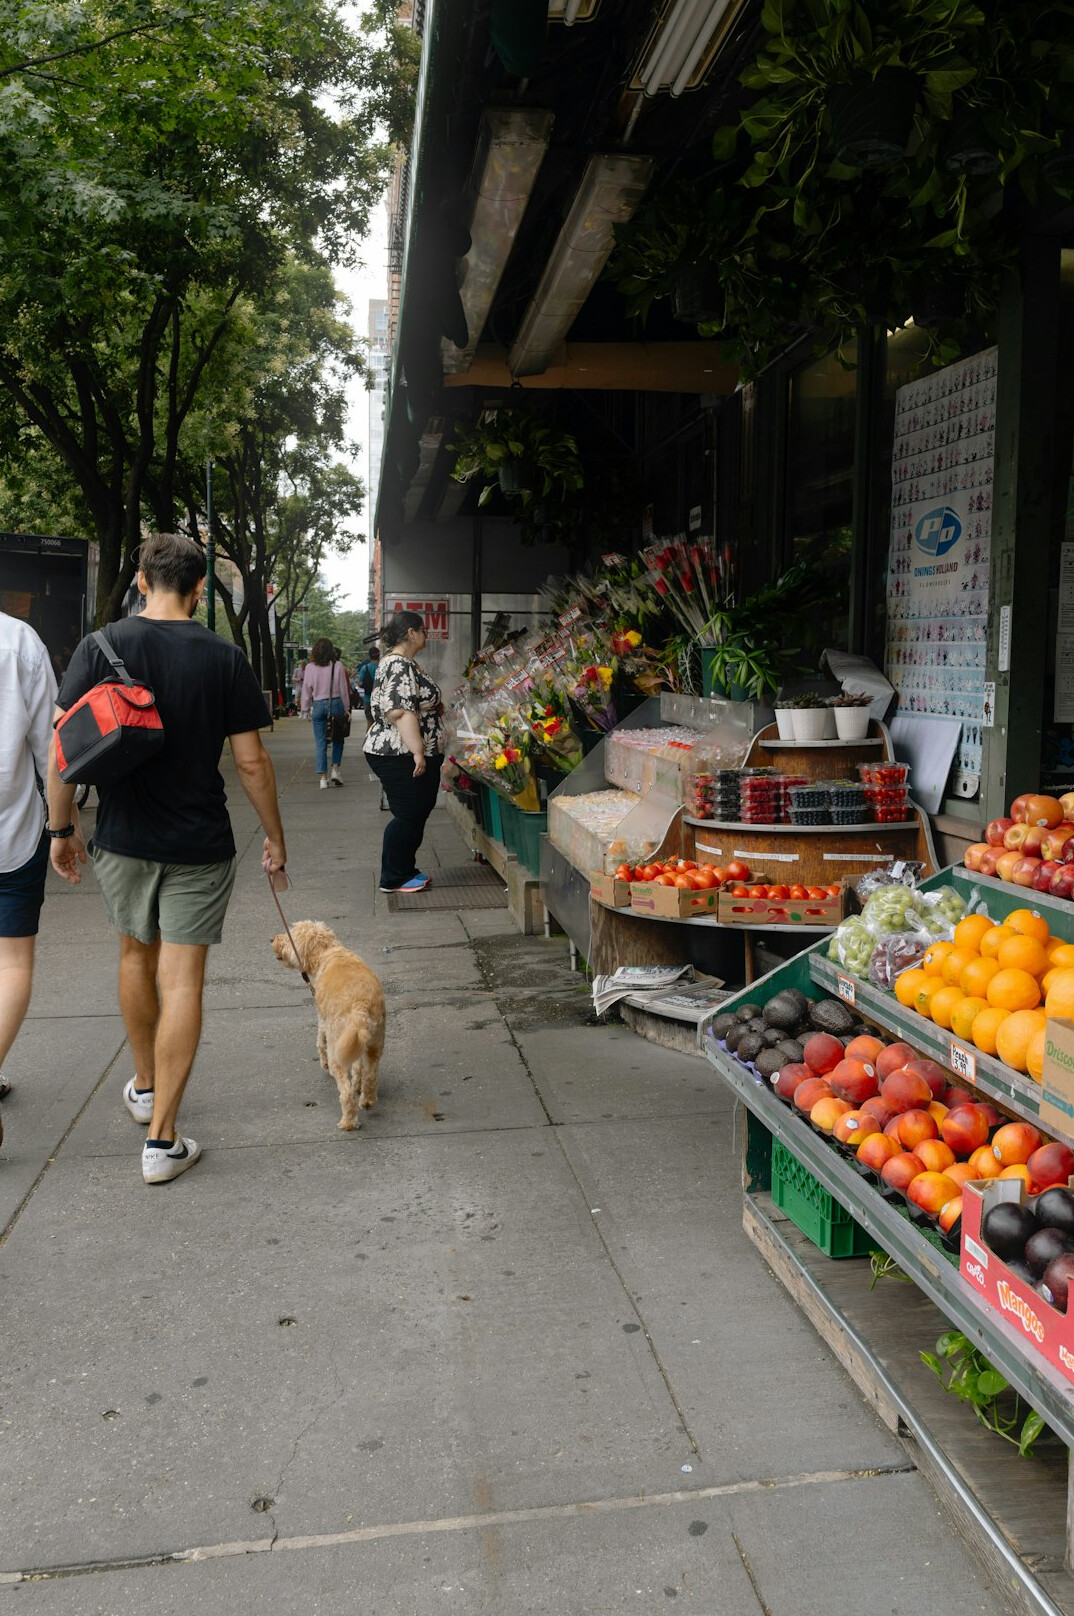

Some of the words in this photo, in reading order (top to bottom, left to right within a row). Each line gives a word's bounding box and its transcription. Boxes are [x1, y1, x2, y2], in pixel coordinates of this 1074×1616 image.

[953, 1044, 968, 1065] Peach
[997, 1280, 1045, 1343] Mangos
[1059, 1344, 1074, 1374] Ma
